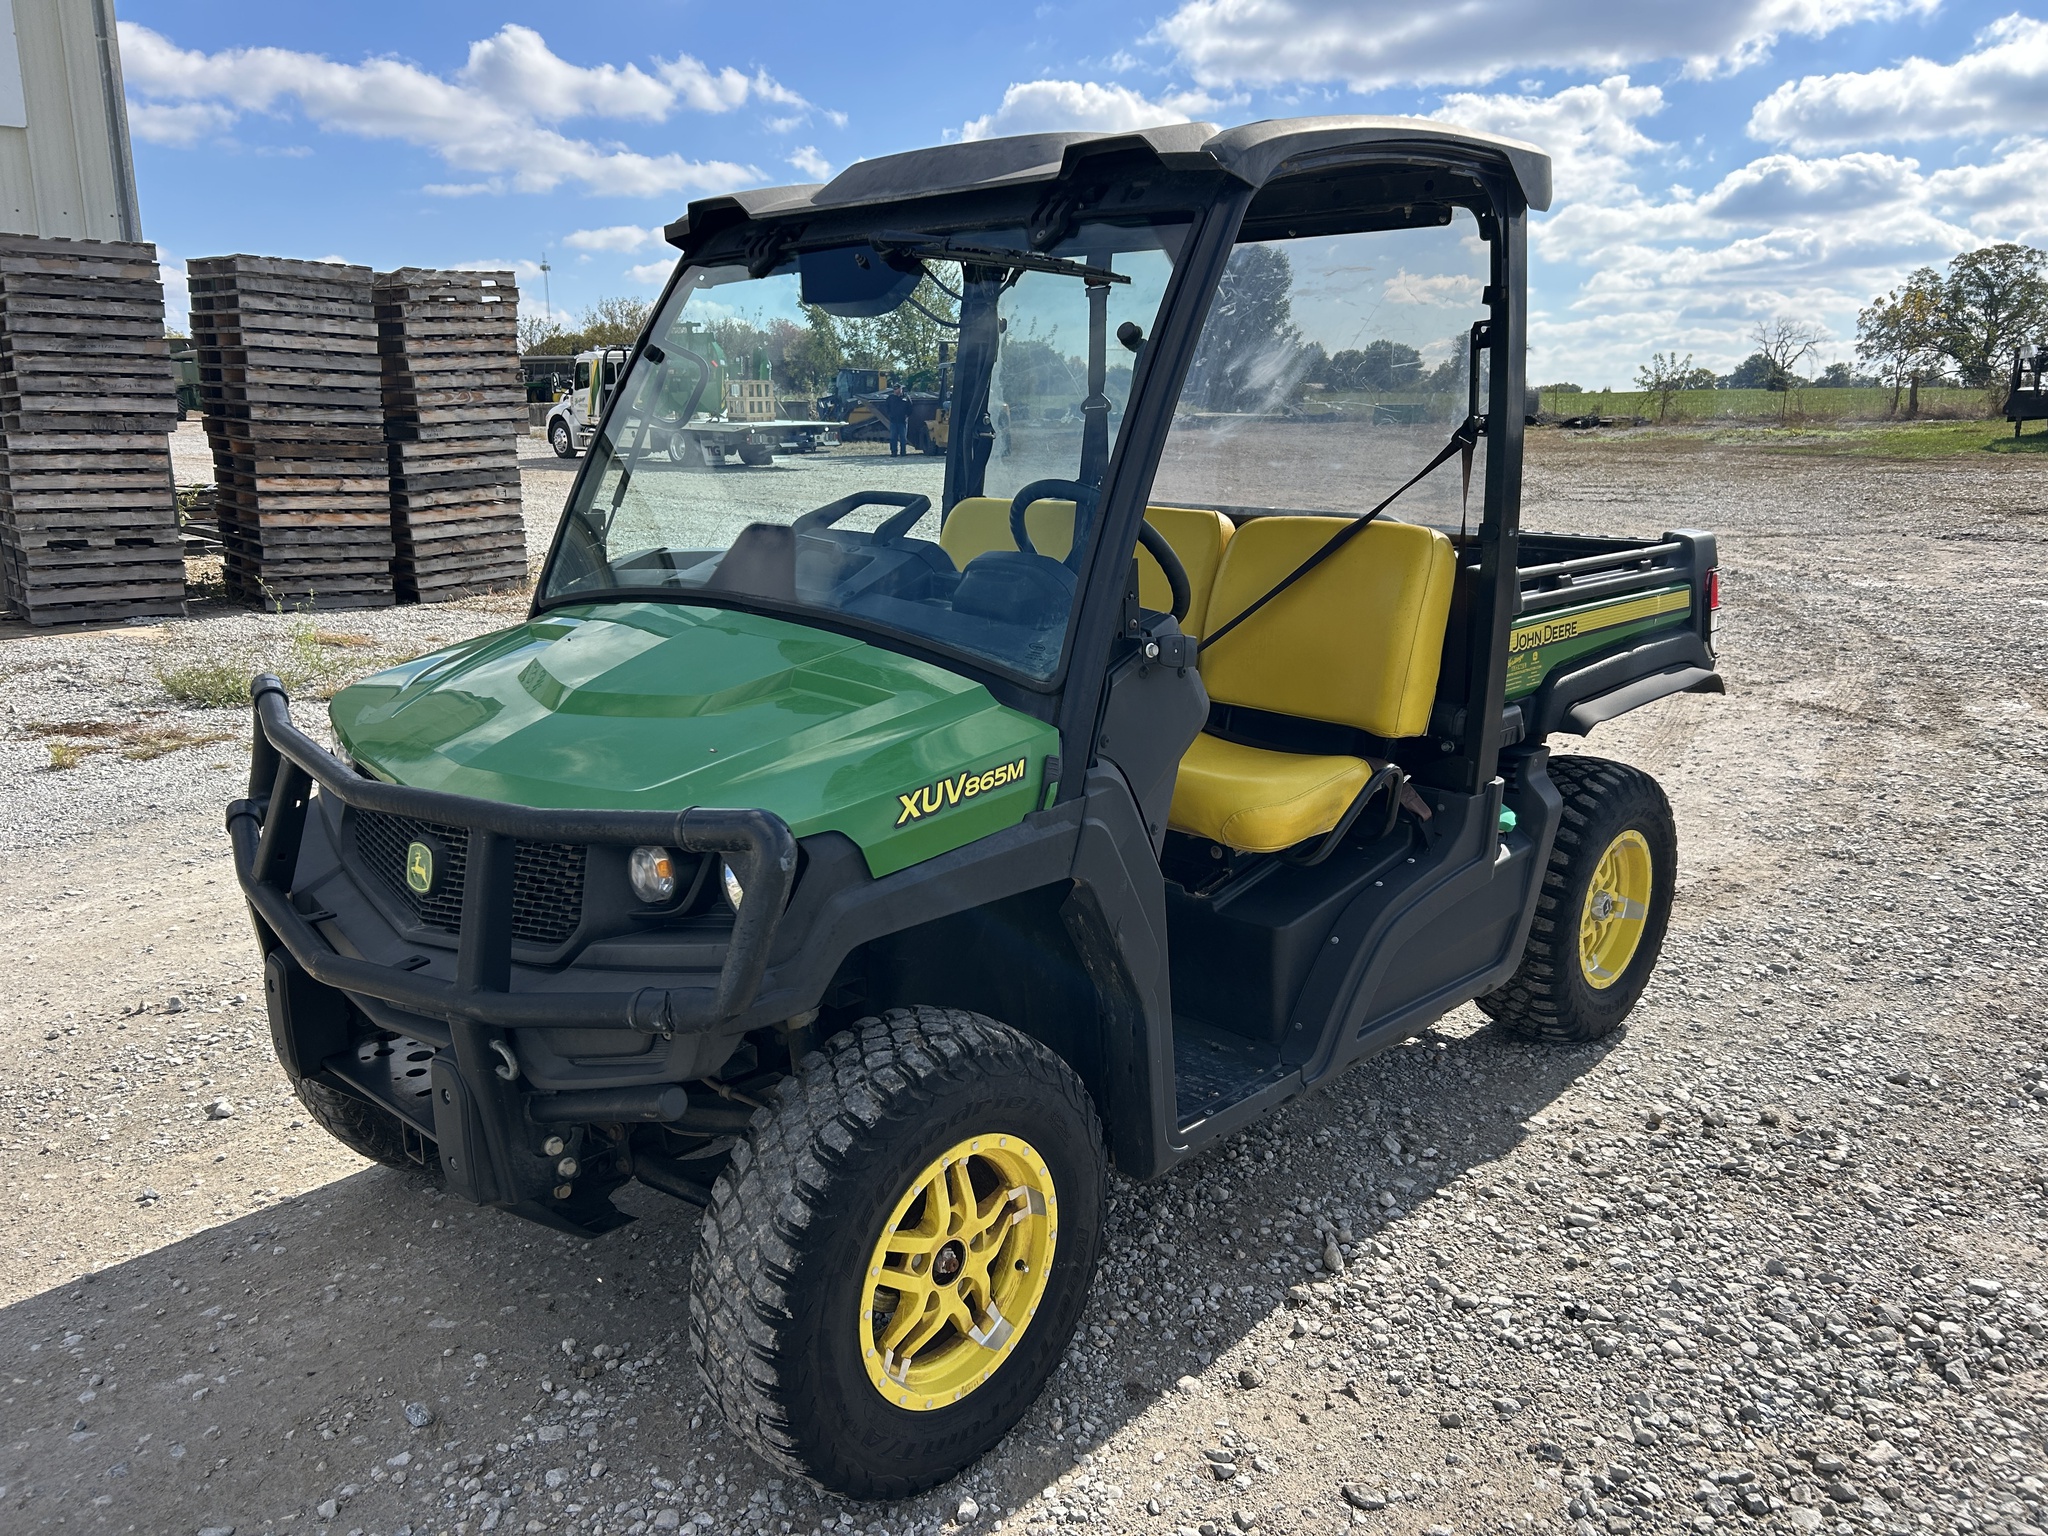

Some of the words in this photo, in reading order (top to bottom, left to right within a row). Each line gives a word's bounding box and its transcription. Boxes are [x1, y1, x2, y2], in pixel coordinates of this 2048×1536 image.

[1512, 630, 1543, 651] JOHN
[1543, 621, 1578, 644] DEERE
[895, 757, 1026, 828] XUV865M
